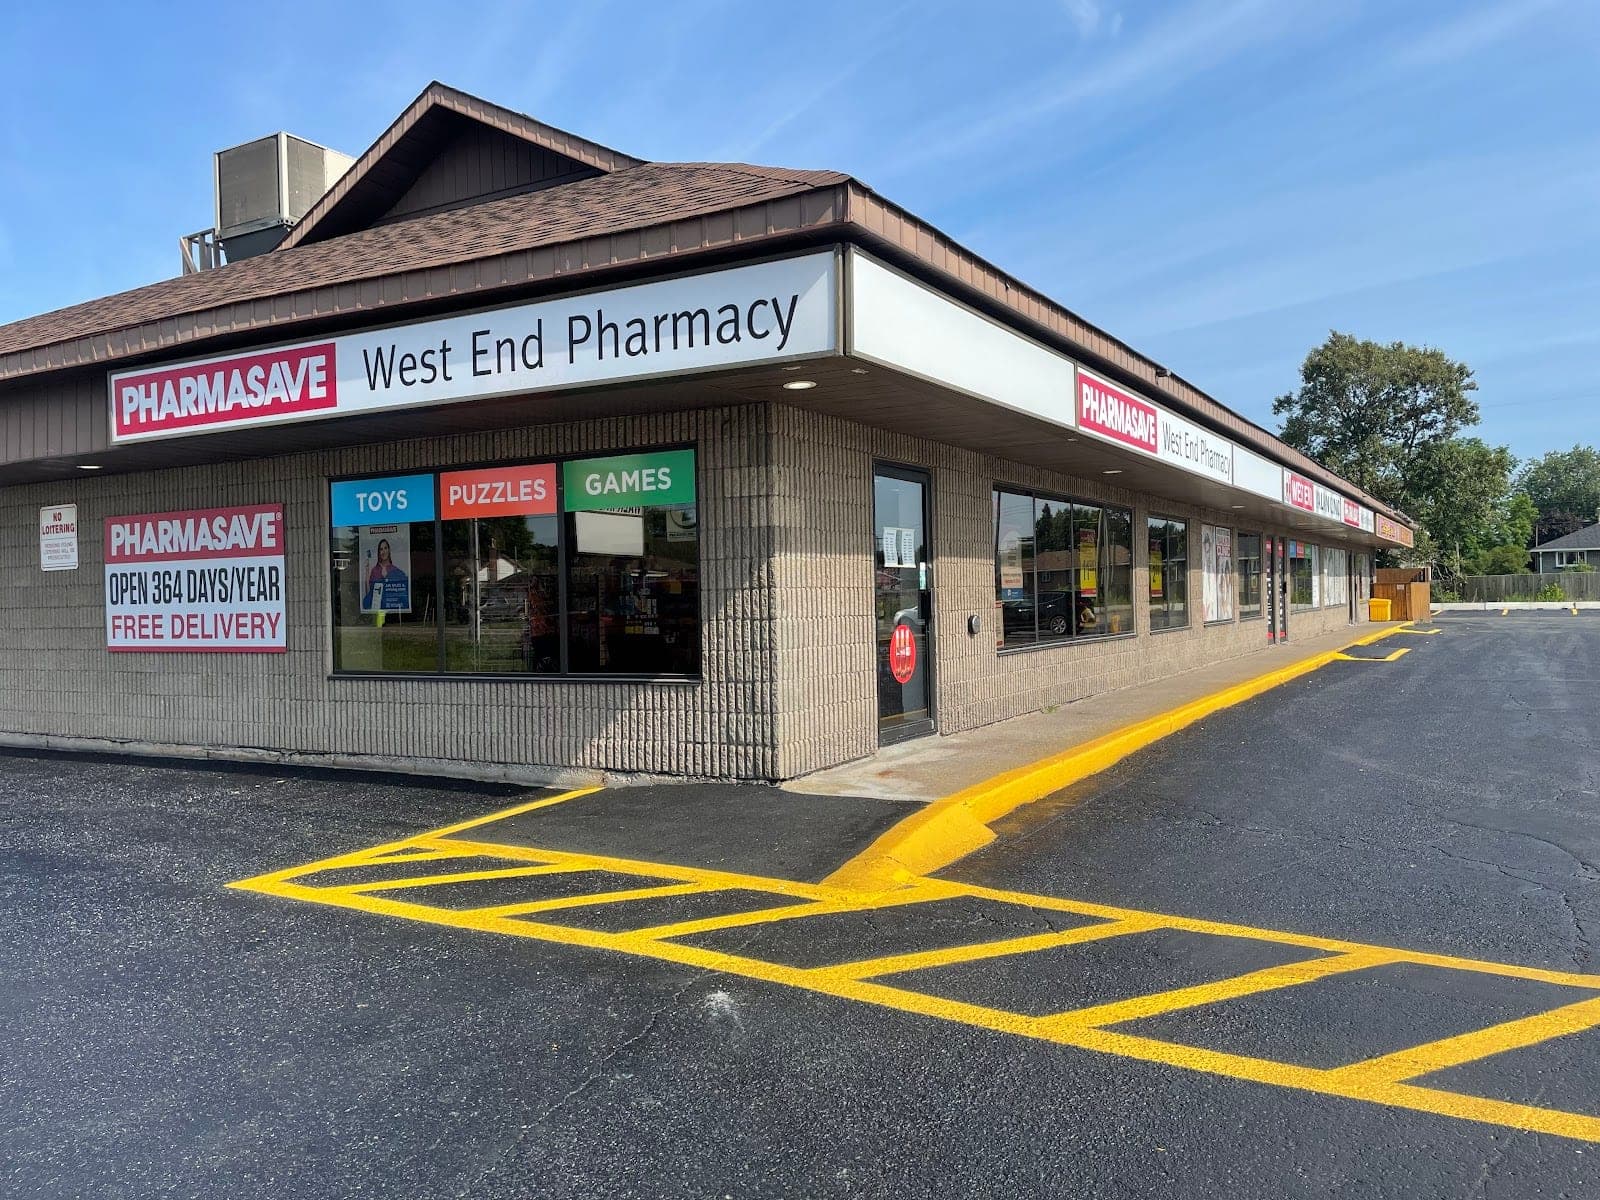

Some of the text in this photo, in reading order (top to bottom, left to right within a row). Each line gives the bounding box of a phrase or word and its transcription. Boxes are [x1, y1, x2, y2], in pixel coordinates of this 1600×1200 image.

[122, 294, 799, 425] PHARMASAVE West End Pharmacy
[1082, 383, 1231, 480] PHARMASAVE West End Pharmacy
[449, 478, 547, 506] PUZZLES
[585, 467, 672, 495] GAMES
[356, 489, 408, 513] TOYS
[42, 523, 75, 535] LOITERING
[53, 511, 62, 521] NO
[111, 512, 276, 556] PHARMASAVE
[110, 565, 280, 605] OPEN 364 DAYS/YEAR
[111, 612, 281, 640] FREE DELIVERY
